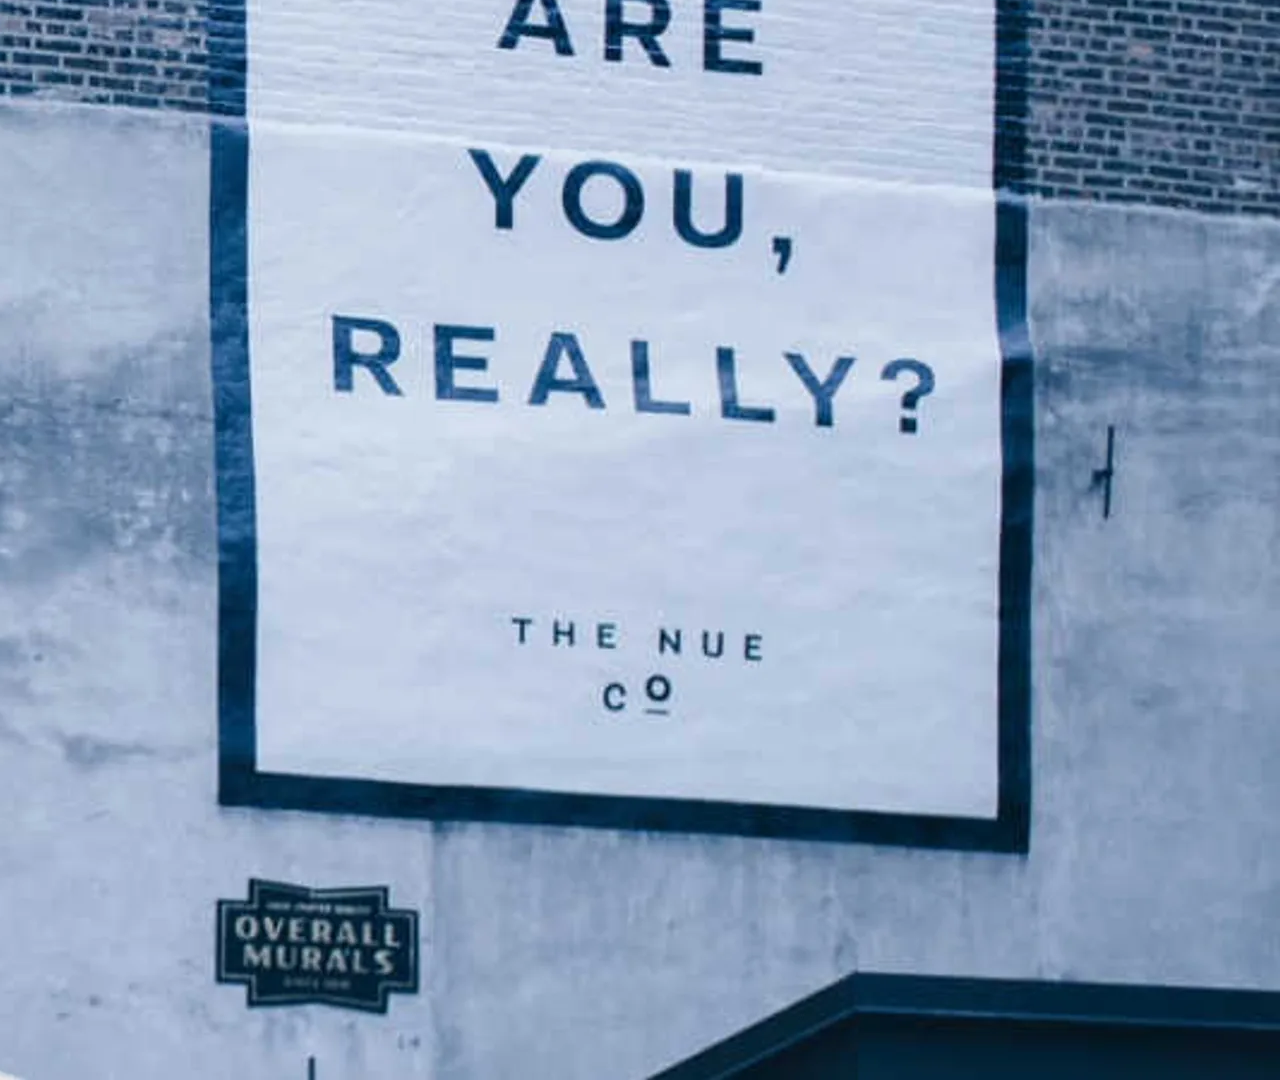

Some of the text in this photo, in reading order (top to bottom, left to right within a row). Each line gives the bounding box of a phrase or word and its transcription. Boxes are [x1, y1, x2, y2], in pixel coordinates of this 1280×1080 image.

[467, 147, 793, 275] YOU,
[331, 314, 937, 435] REALLY?
[511, 617, 764, 662] THE NUE
[602, 673, 673, 715] CO
[234, 915, 401, 949] OVERALL
[241, 943, 395, 976] MURALS
